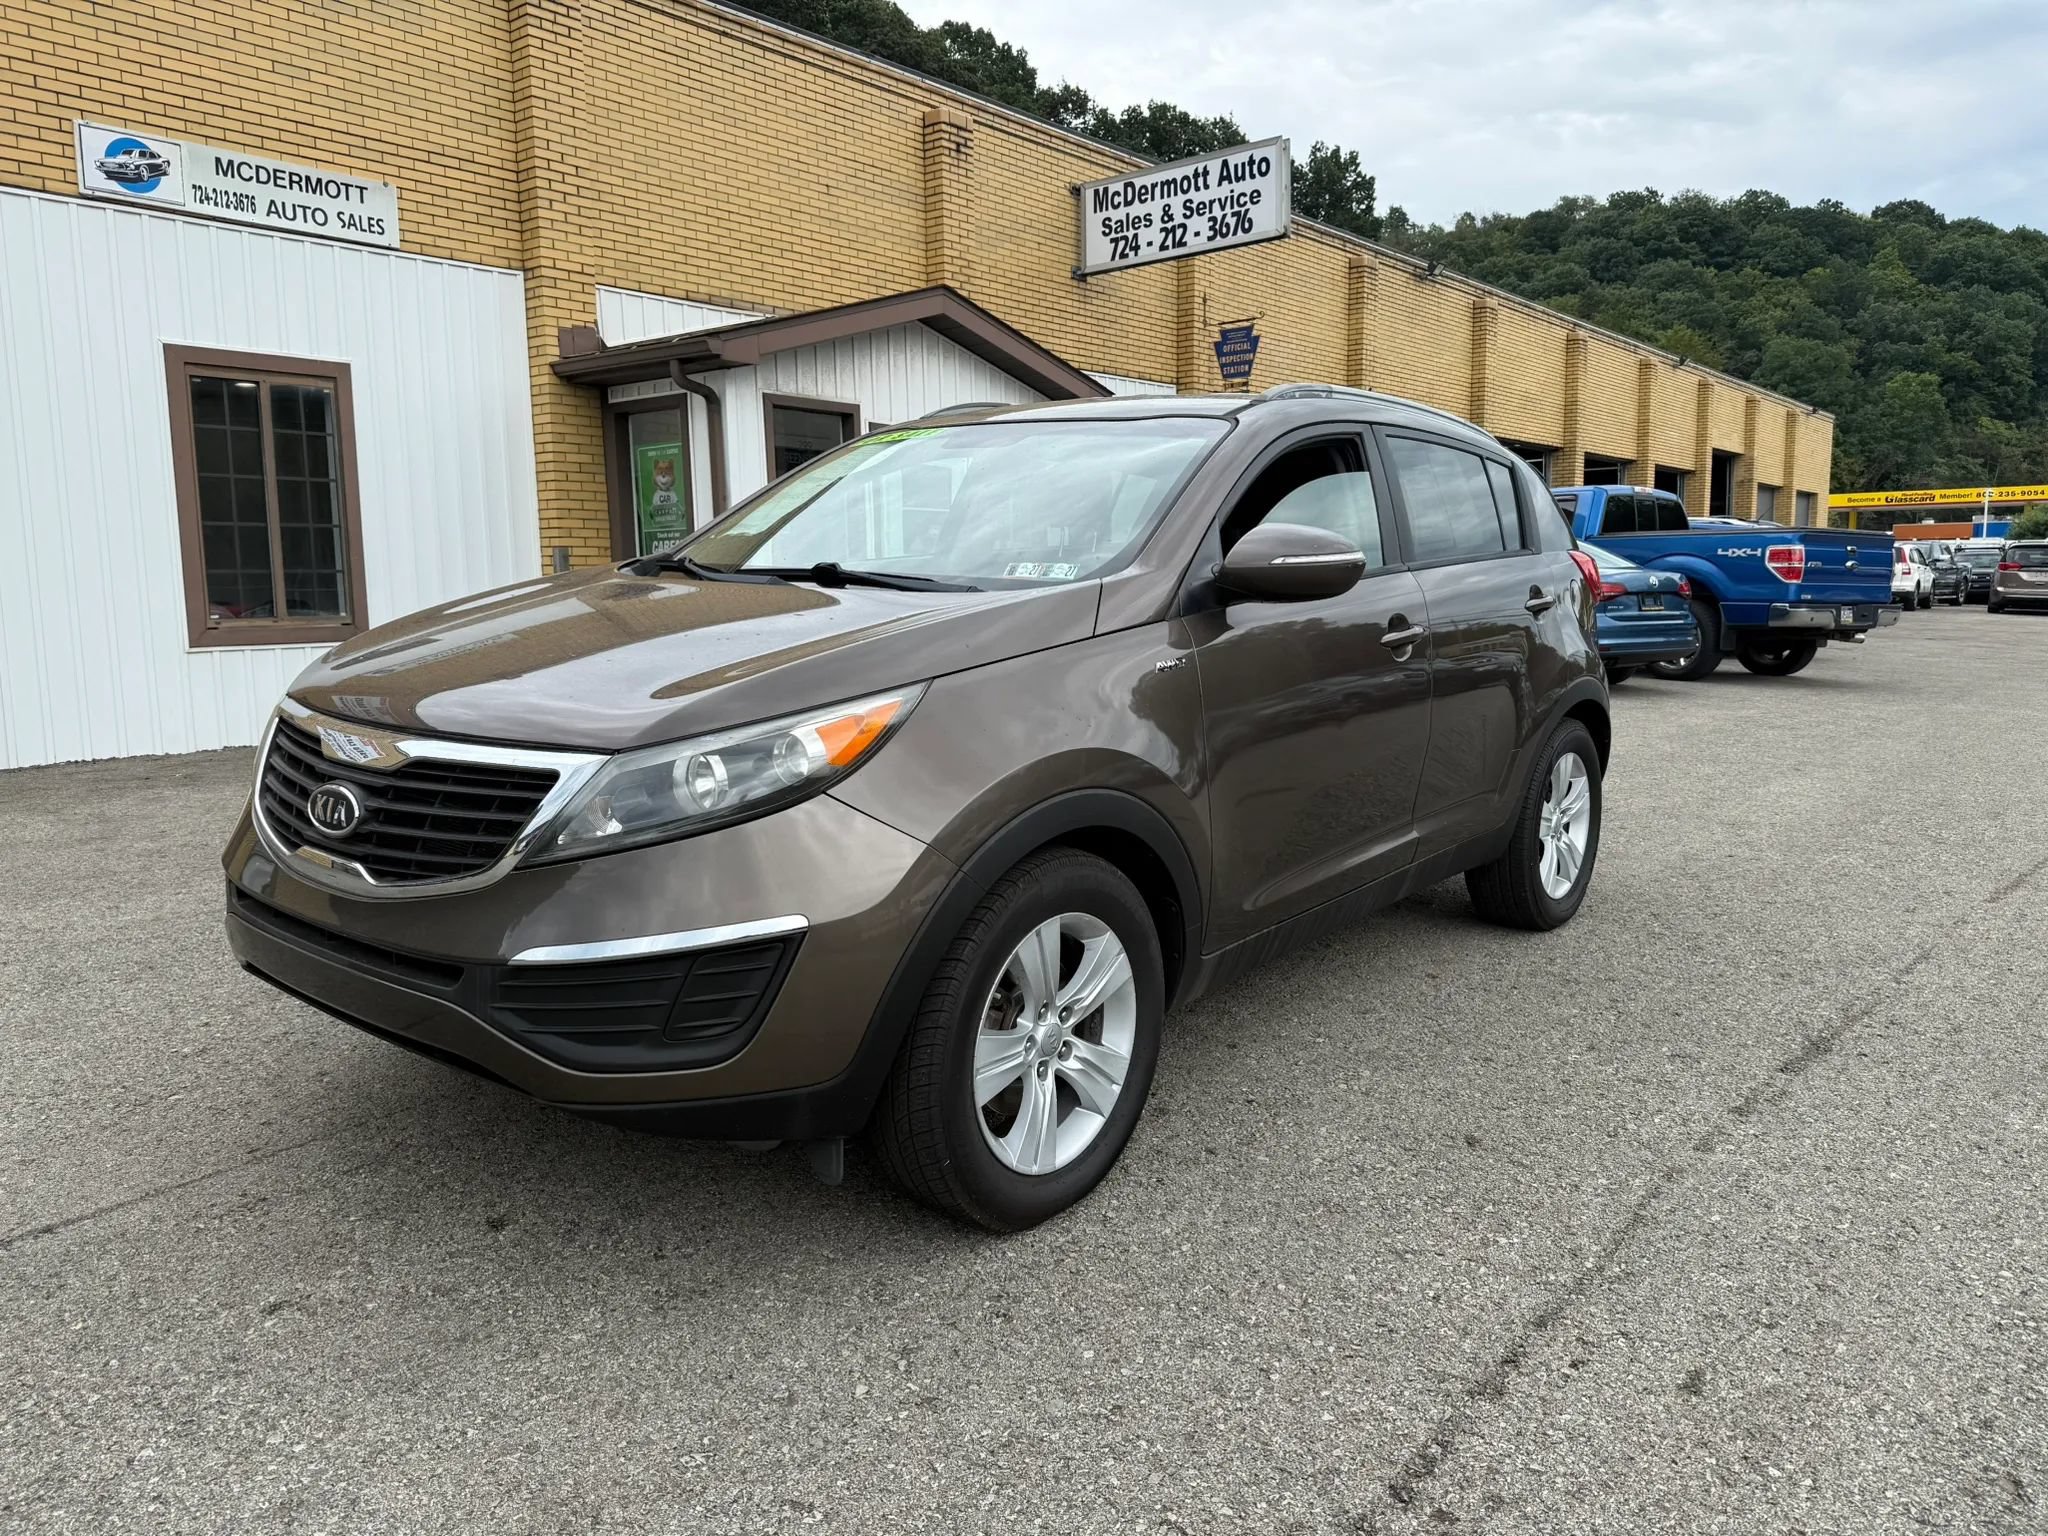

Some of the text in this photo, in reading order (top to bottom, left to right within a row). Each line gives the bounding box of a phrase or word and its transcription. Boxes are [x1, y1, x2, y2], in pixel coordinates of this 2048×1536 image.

[214, 156, 369, 205] MCDERMOTT
[1093, 153, 1271, 214] McDermott Auto
[191, 184, 257, 215] 724-212-3676
[1101, 188, 1262, 238] Sales & Service
[265, 198, 386, 236] AUTO SALES
[1109, 232, 1141, 262] 724
[1158, 222, 1188, 252] 212
[1206, 207, 1254, 242] 3676
[1219, 353, 1254, 364] INSPECTION
[1222, 342, 1252, 353] OFFICIAL
[1223, 364, 1249, 375] STATION
[1847, 496, 1876, 504] Become
[1885, 493, 1936, 504] Glasscard
[313, 794, 347, 828] KIA
